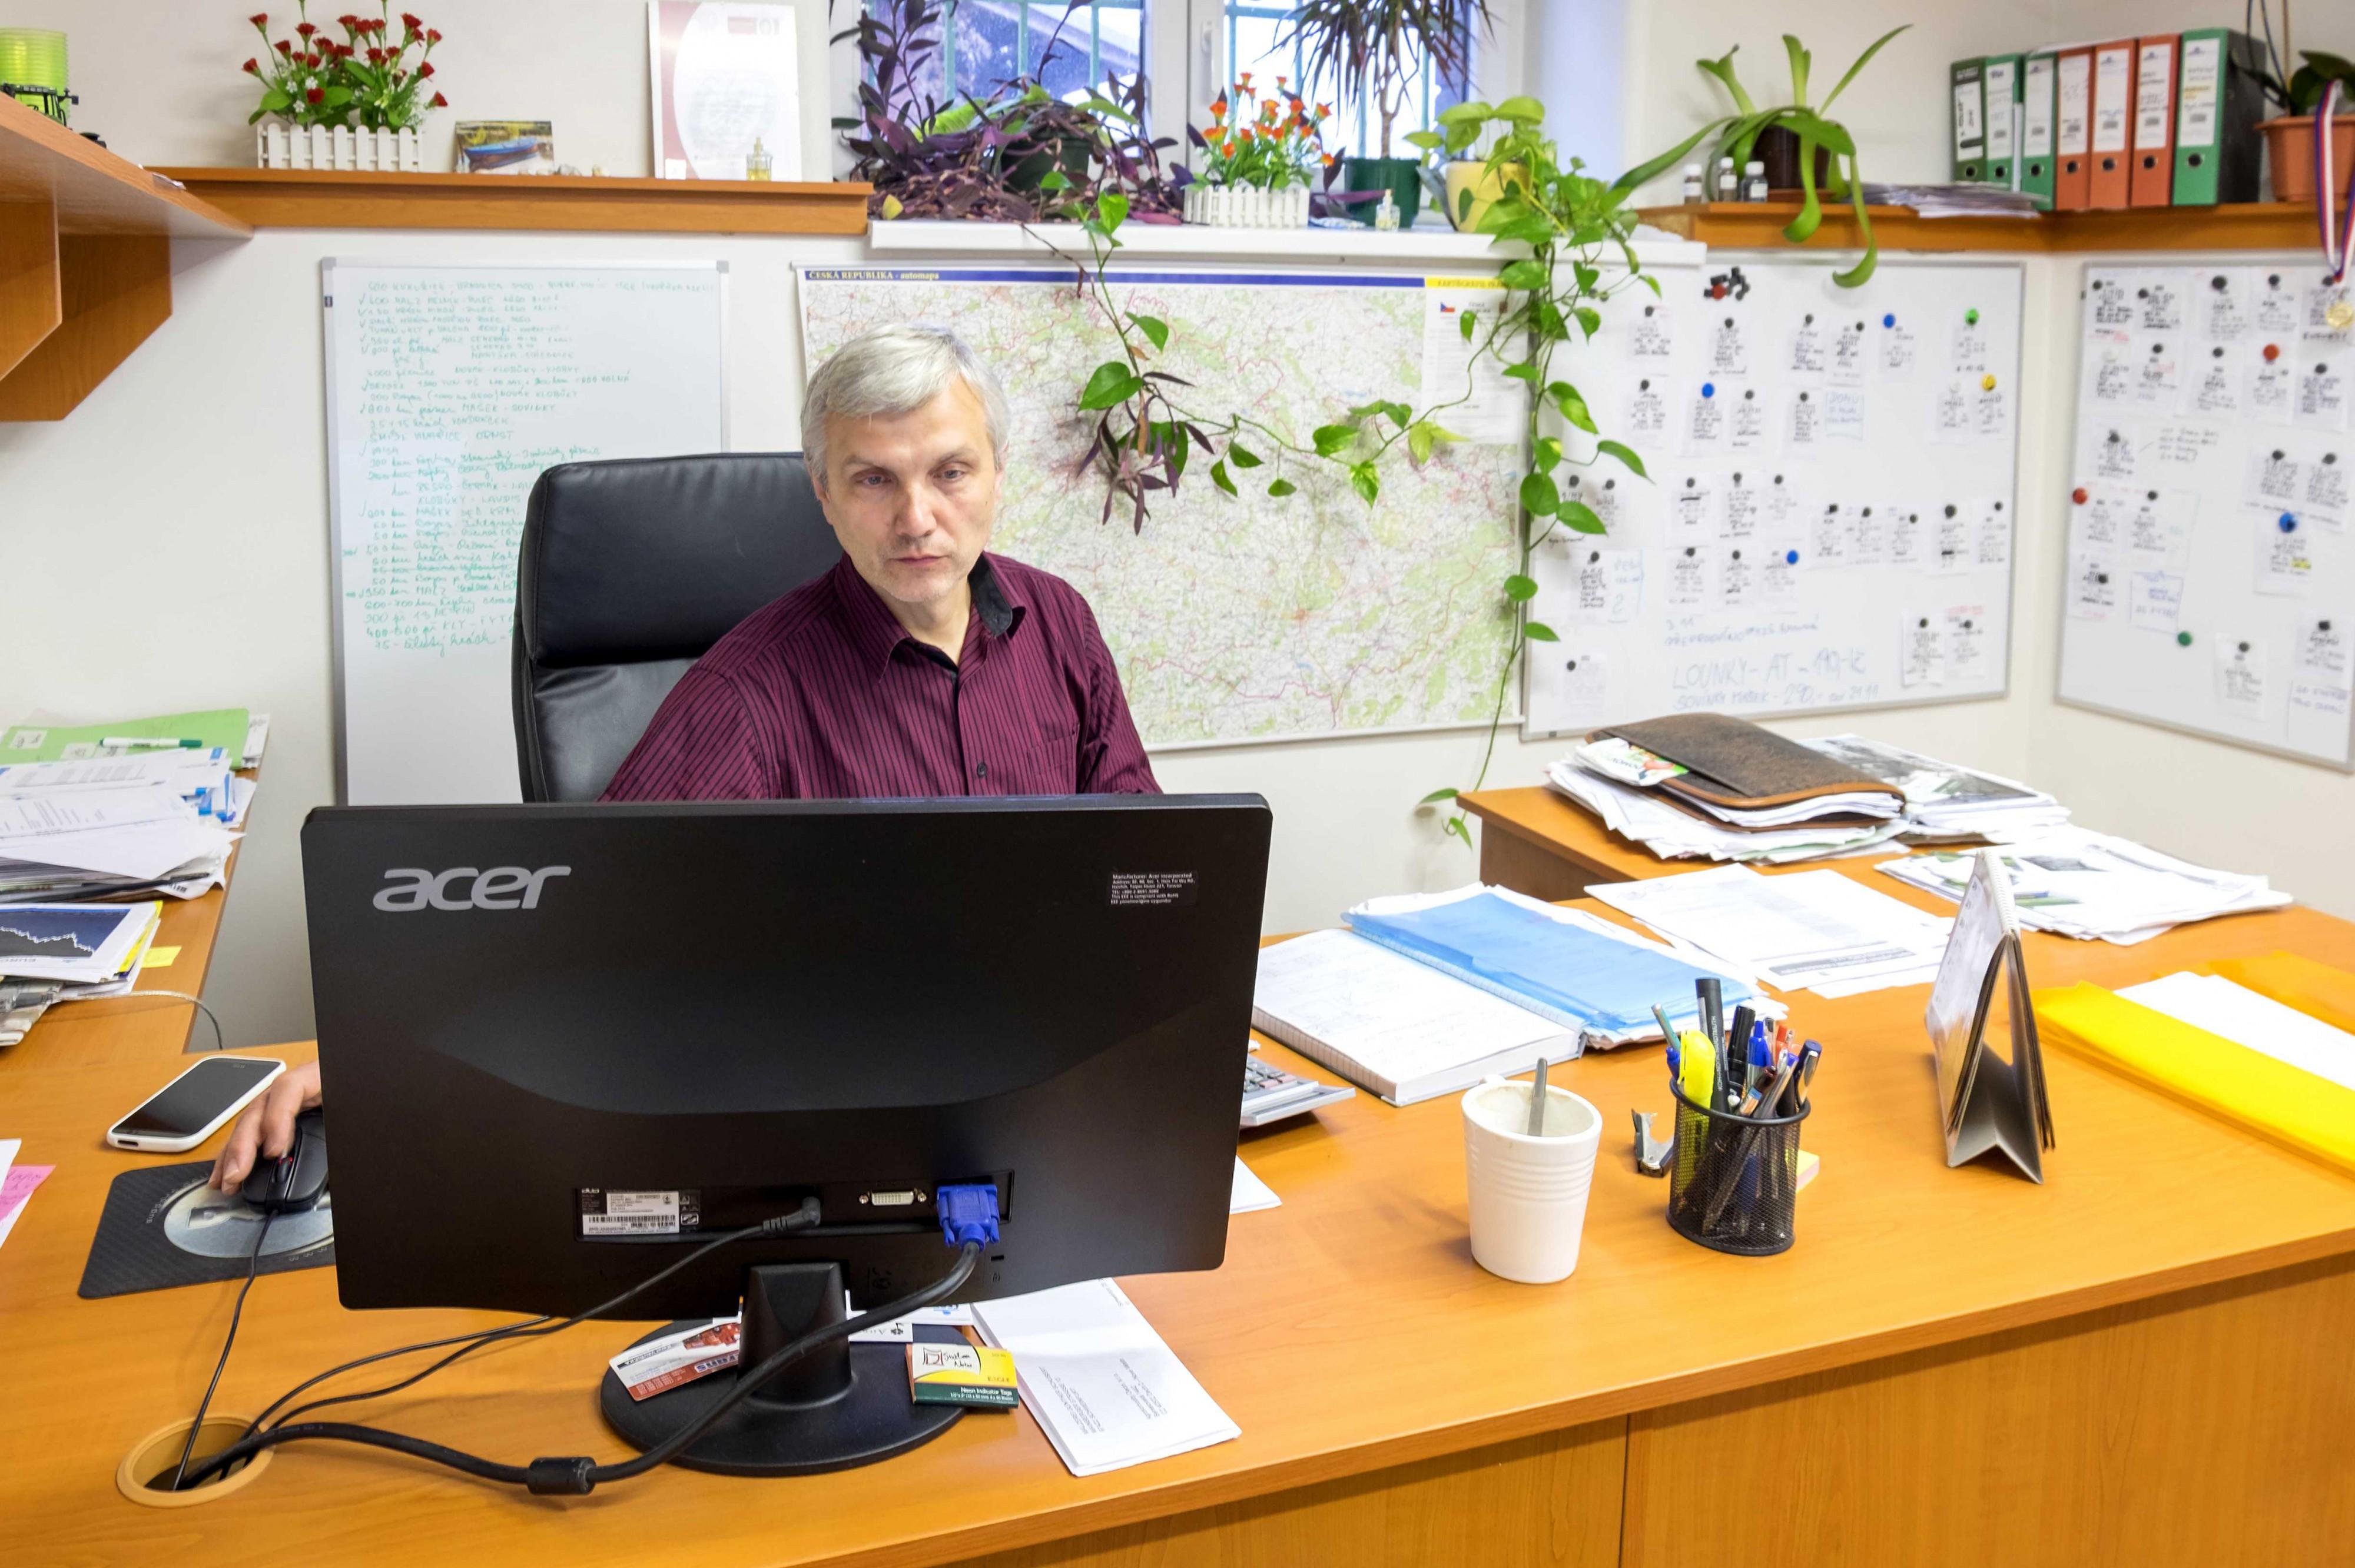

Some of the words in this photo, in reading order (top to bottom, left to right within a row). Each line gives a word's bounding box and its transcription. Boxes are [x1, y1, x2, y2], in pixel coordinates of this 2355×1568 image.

[809, 270, 839, 280] ČESKÁ
[841, 271, 893, 280] REPUBLIKA
[900, 272, 939, 281] automapa
[373, 865, 572, 912] acer
